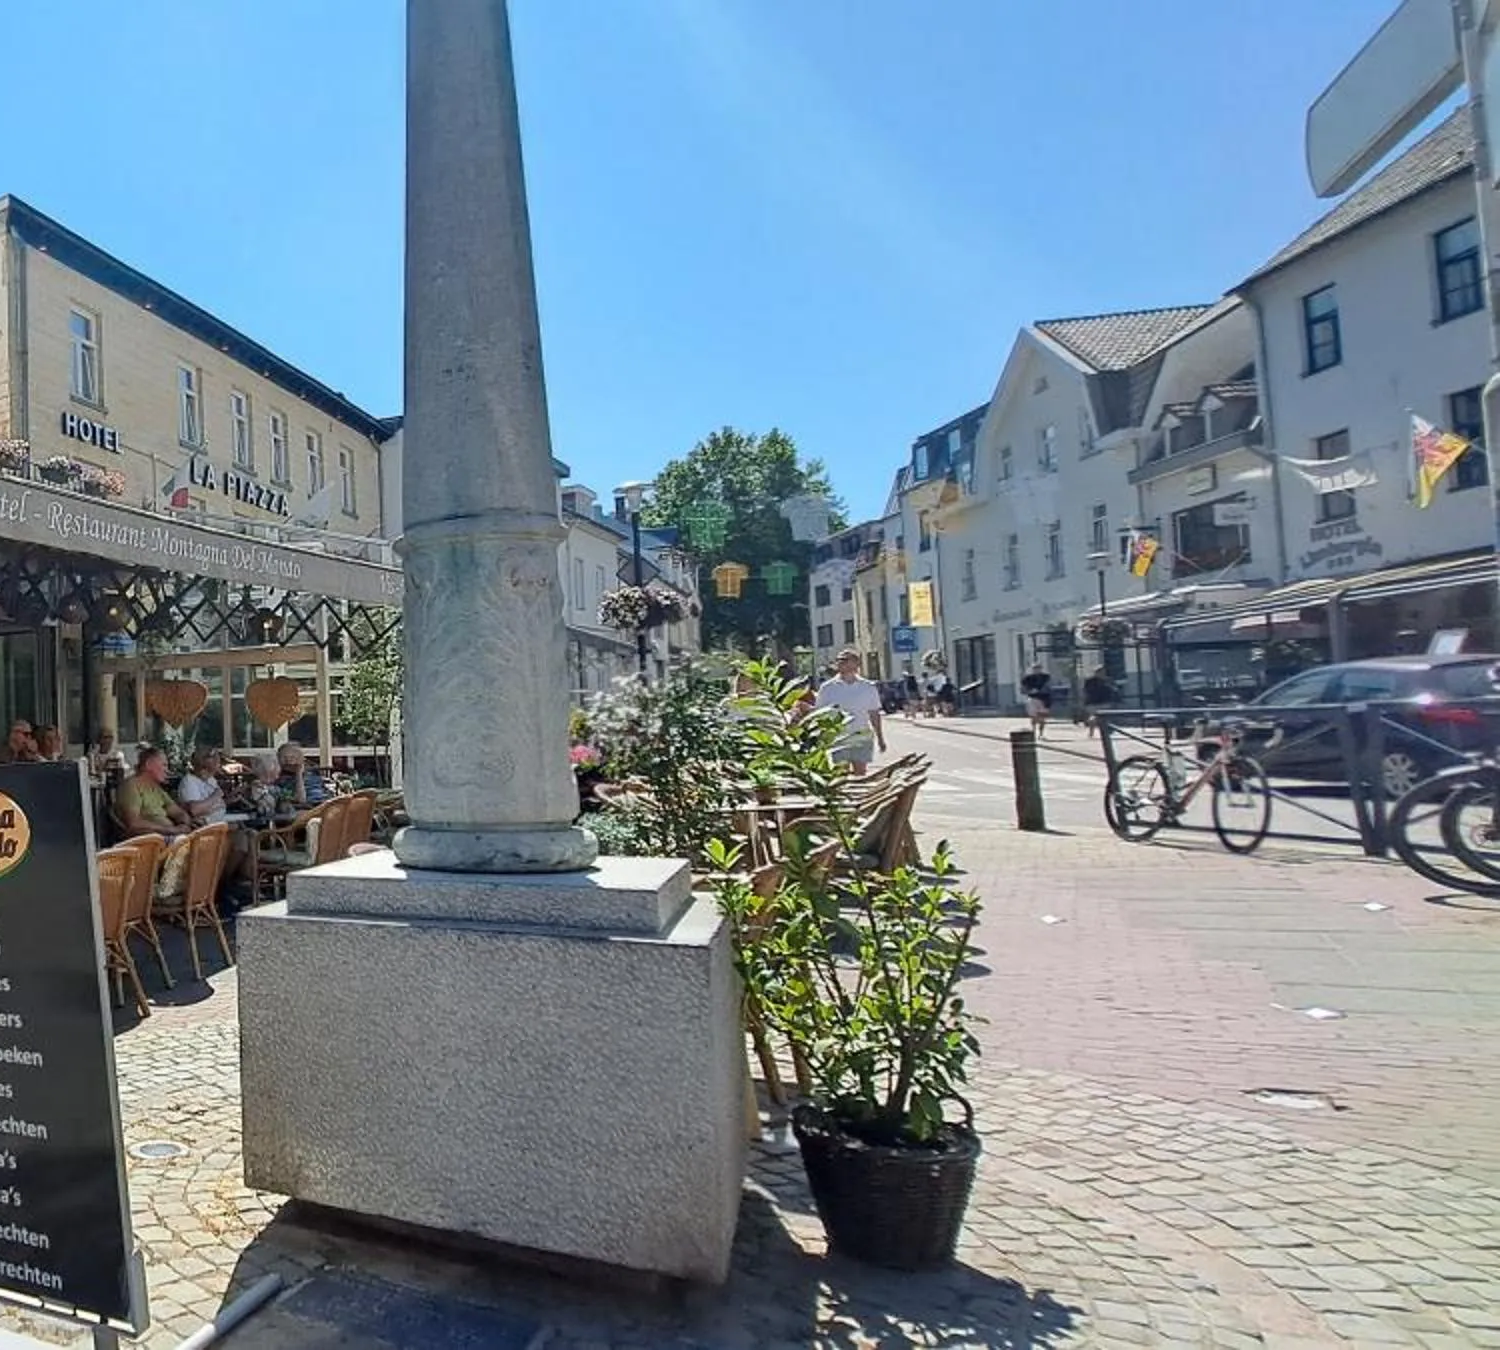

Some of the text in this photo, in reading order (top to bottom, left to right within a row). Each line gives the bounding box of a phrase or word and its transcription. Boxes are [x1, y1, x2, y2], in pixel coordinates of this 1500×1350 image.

[62, 411, 125, 454] HOTEL
[190, 453, 293, 520] LA PIAZZA
[48, 501, 147, 549] Restaurant
[151, 527, 228, 571] Montagna
[231, 545, 257, 571] Del
